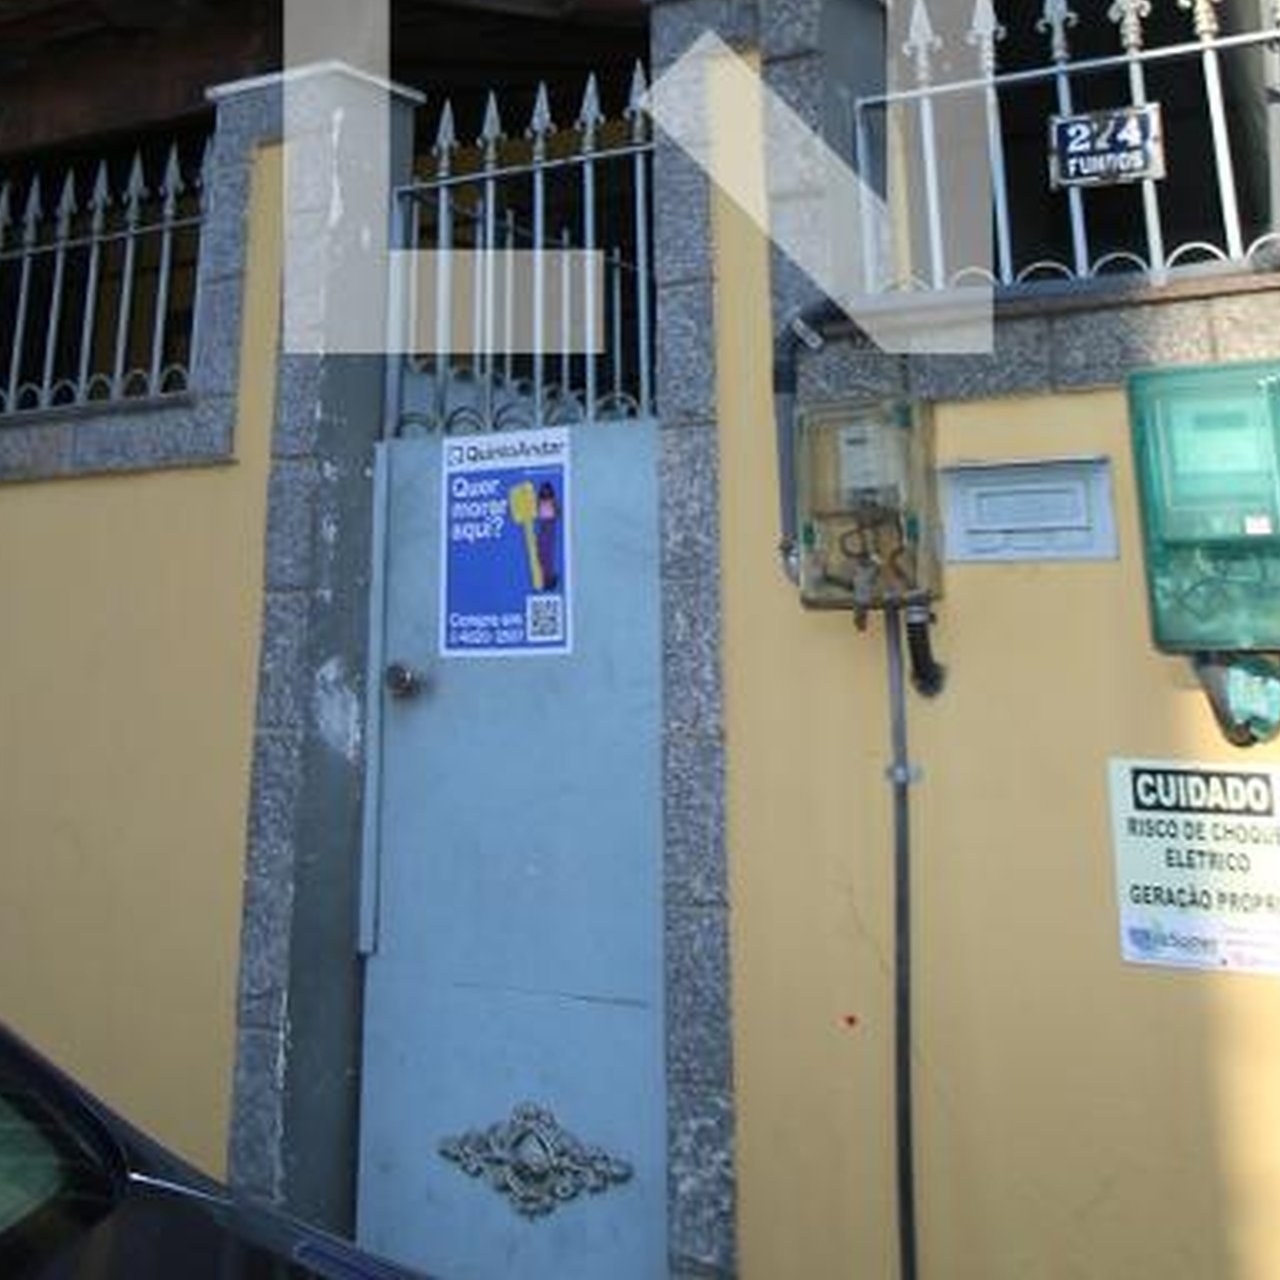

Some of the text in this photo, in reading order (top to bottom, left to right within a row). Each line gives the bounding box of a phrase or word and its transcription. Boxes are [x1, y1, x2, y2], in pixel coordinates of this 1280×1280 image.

[452, 477, 501, 498] Quer
[452, 515, 504, 542] aqui?
[1135, 773, 1270, 812] CUIDADO
[1127, 817, 1178, 839] RISCO
[1183, 821, 1206, 841] DE
